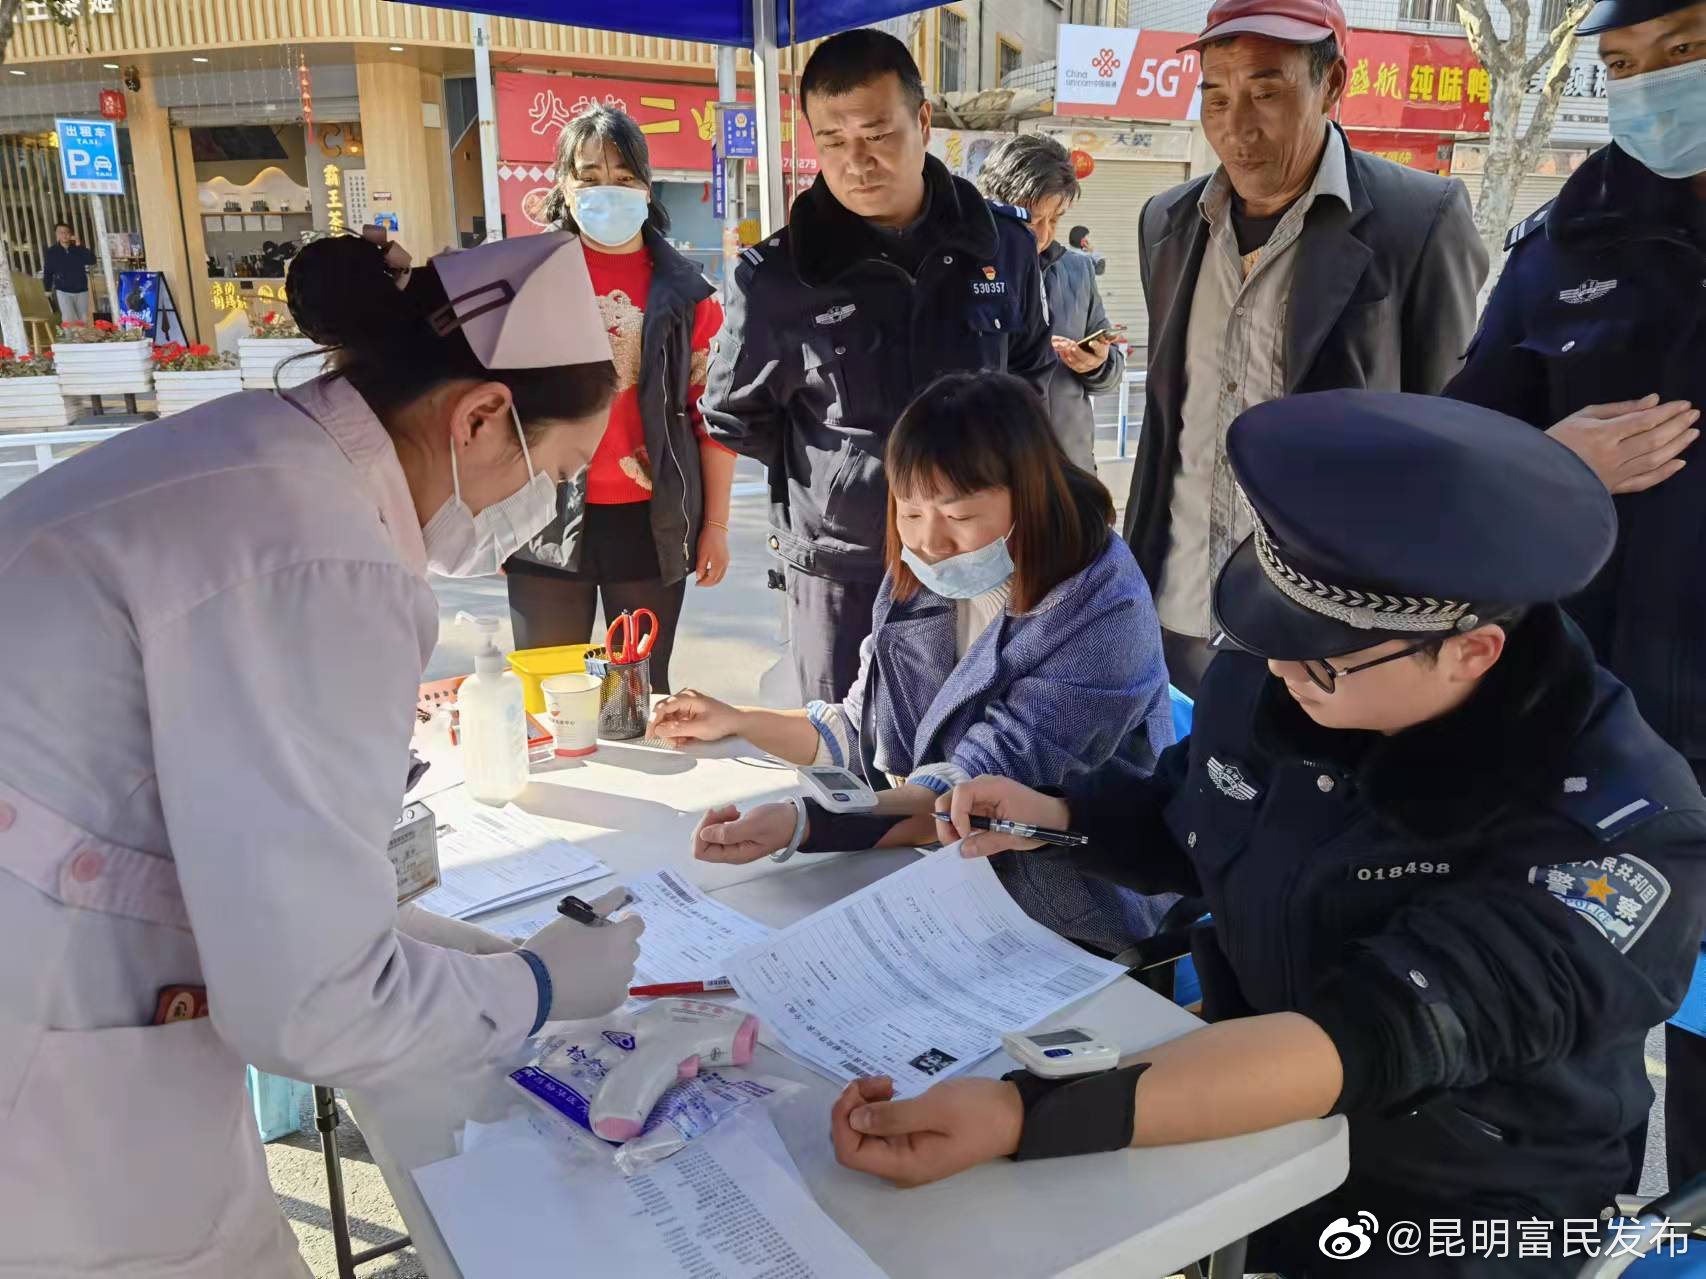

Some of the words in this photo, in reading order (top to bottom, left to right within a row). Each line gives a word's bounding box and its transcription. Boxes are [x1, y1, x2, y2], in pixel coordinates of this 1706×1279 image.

[1065, 69, 1088, 79] China
[1408, 64, 1490, 104] 纯味鸭
[66, 125, 107, 138] 出租车
[67, 149, 91, 176] P
[323, 164, 344, 237] 霸王茶
[973, 281, 1006, 295] 530357
[1356, 861, 1451, 881] 018498
[1614, 895, 1643, 923] 察
